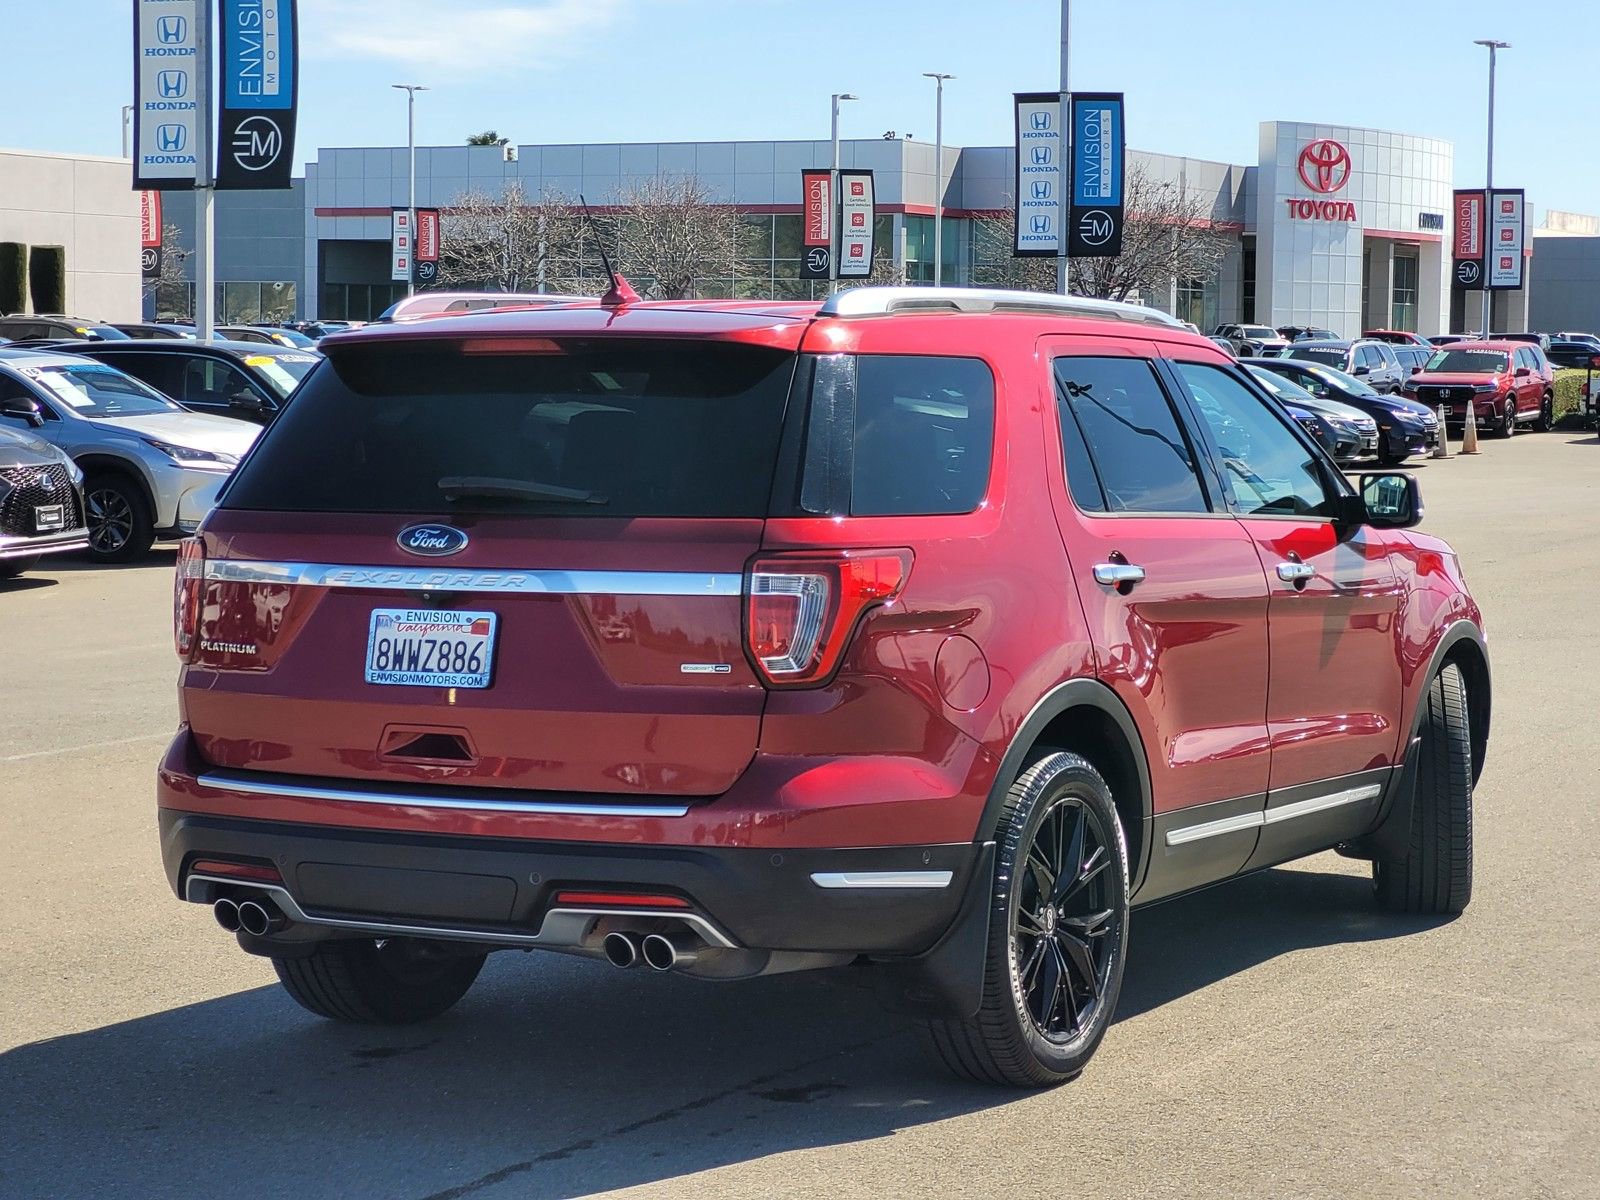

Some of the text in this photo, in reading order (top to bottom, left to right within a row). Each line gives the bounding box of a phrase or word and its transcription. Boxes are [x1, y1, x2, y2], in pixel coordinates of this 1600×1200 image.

[239, 0, 261, 95] ENVISI
[144, 155, 197, 164] HONDA
[1083, 109, 1101, 198] ENVISION
[1102, 117, 1110, 190] MOTORS
[810, 180, 821, 240] ENVISION
[1287, 199, 1356, 221] TOYOTA
[1461, 199, 1471, 253] ENVISION
[409, 528, 450, 549] Ford
[335, 569, 527, 587] EXPLORER
[407, 611, 460, 623] ENVISION
[201, 641, 256, 654] PLATINUM
[376, 639, 483, 673] 8WWZ886
[370, 672, 483, 686] ENVISIONMOTORS.COM
